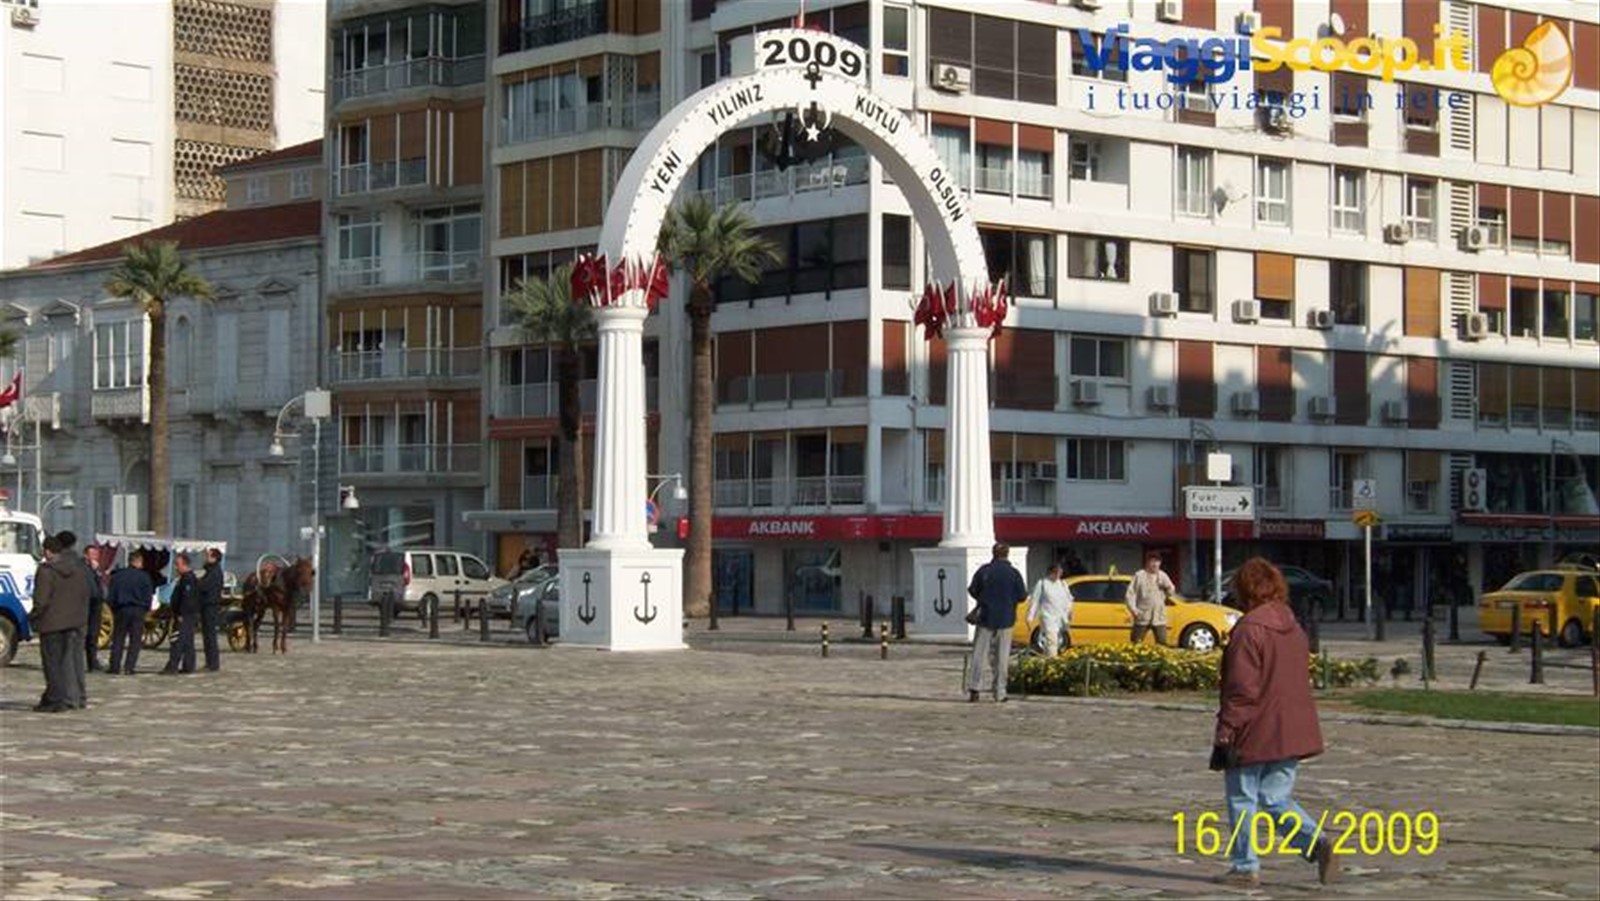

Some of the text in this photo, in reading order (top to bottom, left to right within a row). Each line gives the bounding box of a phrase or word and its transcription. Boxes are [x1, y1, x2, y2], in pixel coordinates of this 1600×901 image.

[762, 38, 862, 77] 2009
[707, 84, 764, 126] YILINIZ
[855, 95, 900, 135] KUTLU
[929, 167, 964, 222] OLSUN
[749, 520, 815, 535] AKBANK
[1076, 520, 1151, 535] AKBANK
